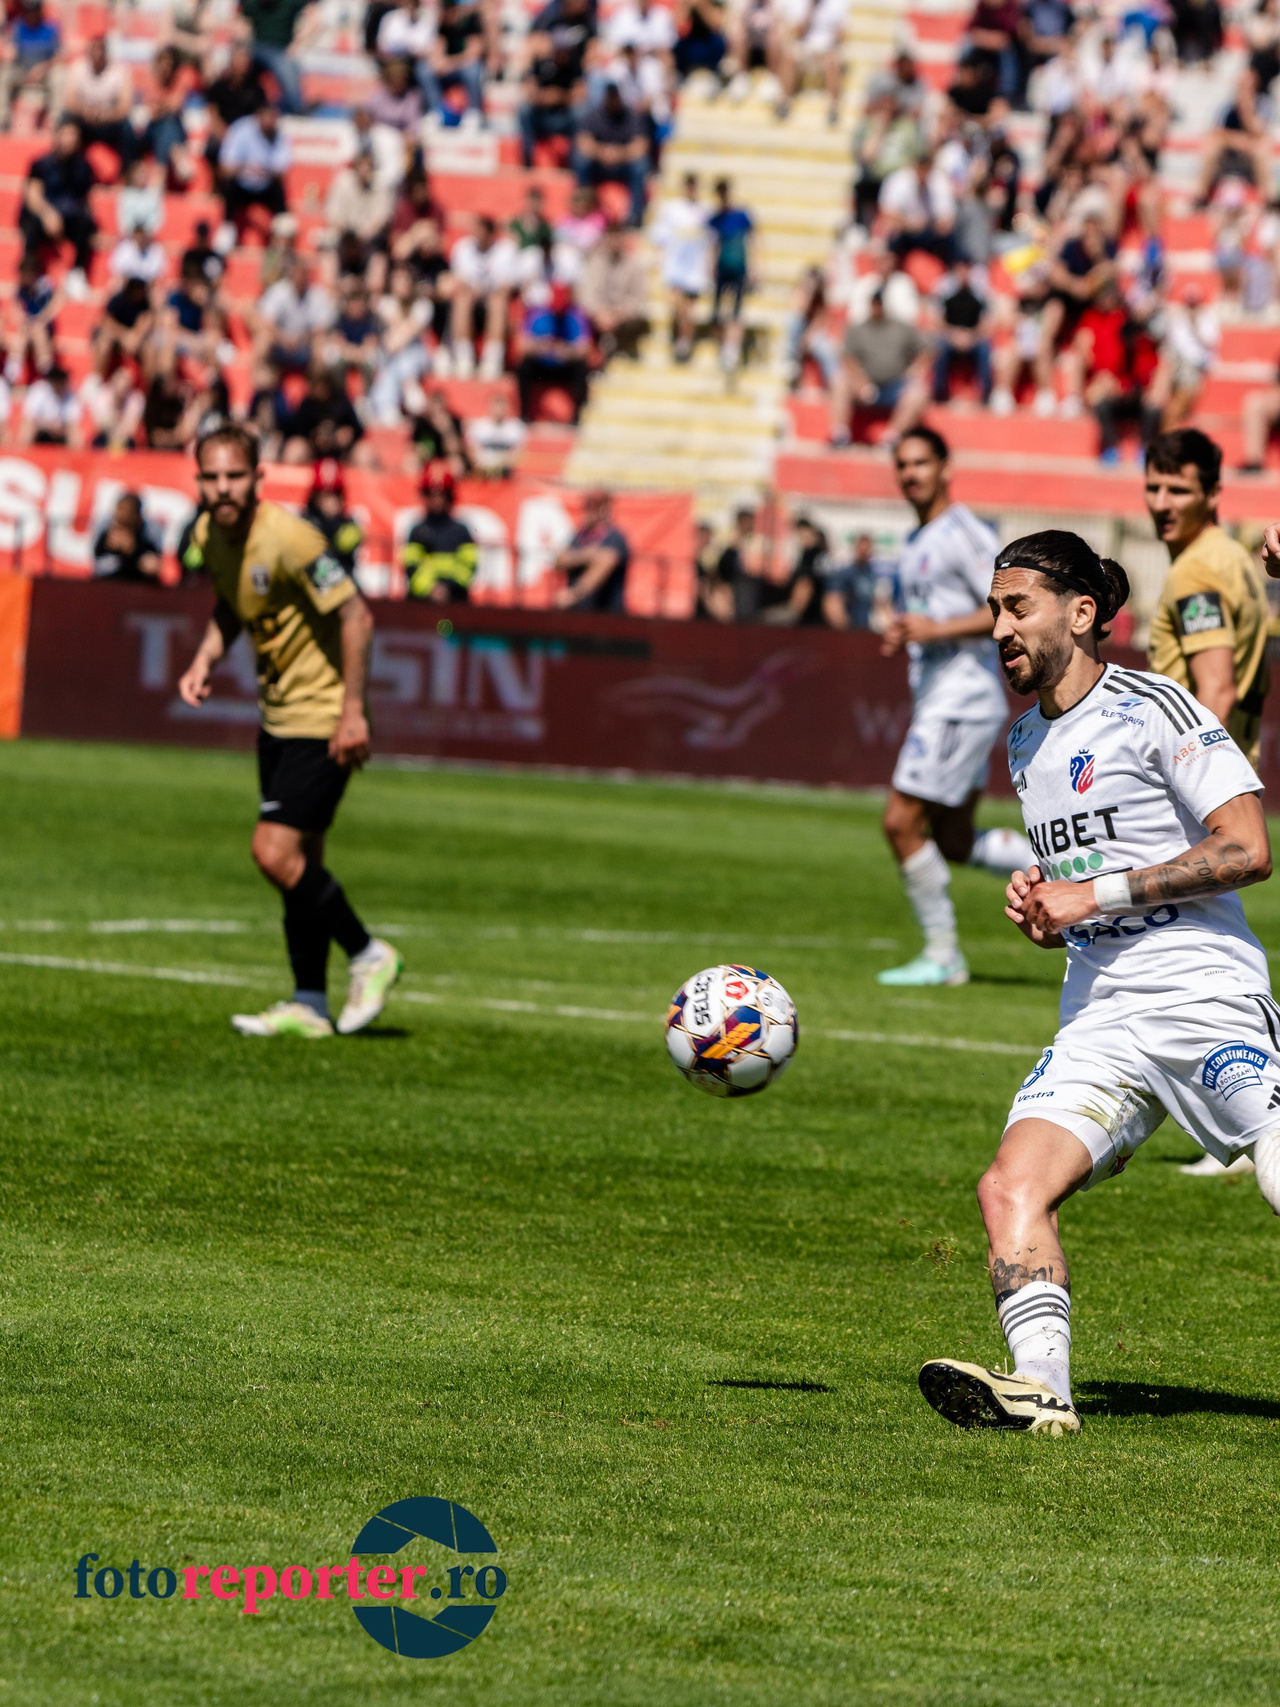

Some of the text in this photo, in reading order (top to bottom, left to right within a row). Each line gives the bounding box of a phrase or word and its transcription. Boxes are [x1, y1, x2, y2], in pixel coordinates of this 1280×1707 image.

[1028, 805, 1119, 859] NIBET
[1066, 903, 1180, 947] SACO
[1205, 1049, 1265, 1087] FIVE CONTINENTS
